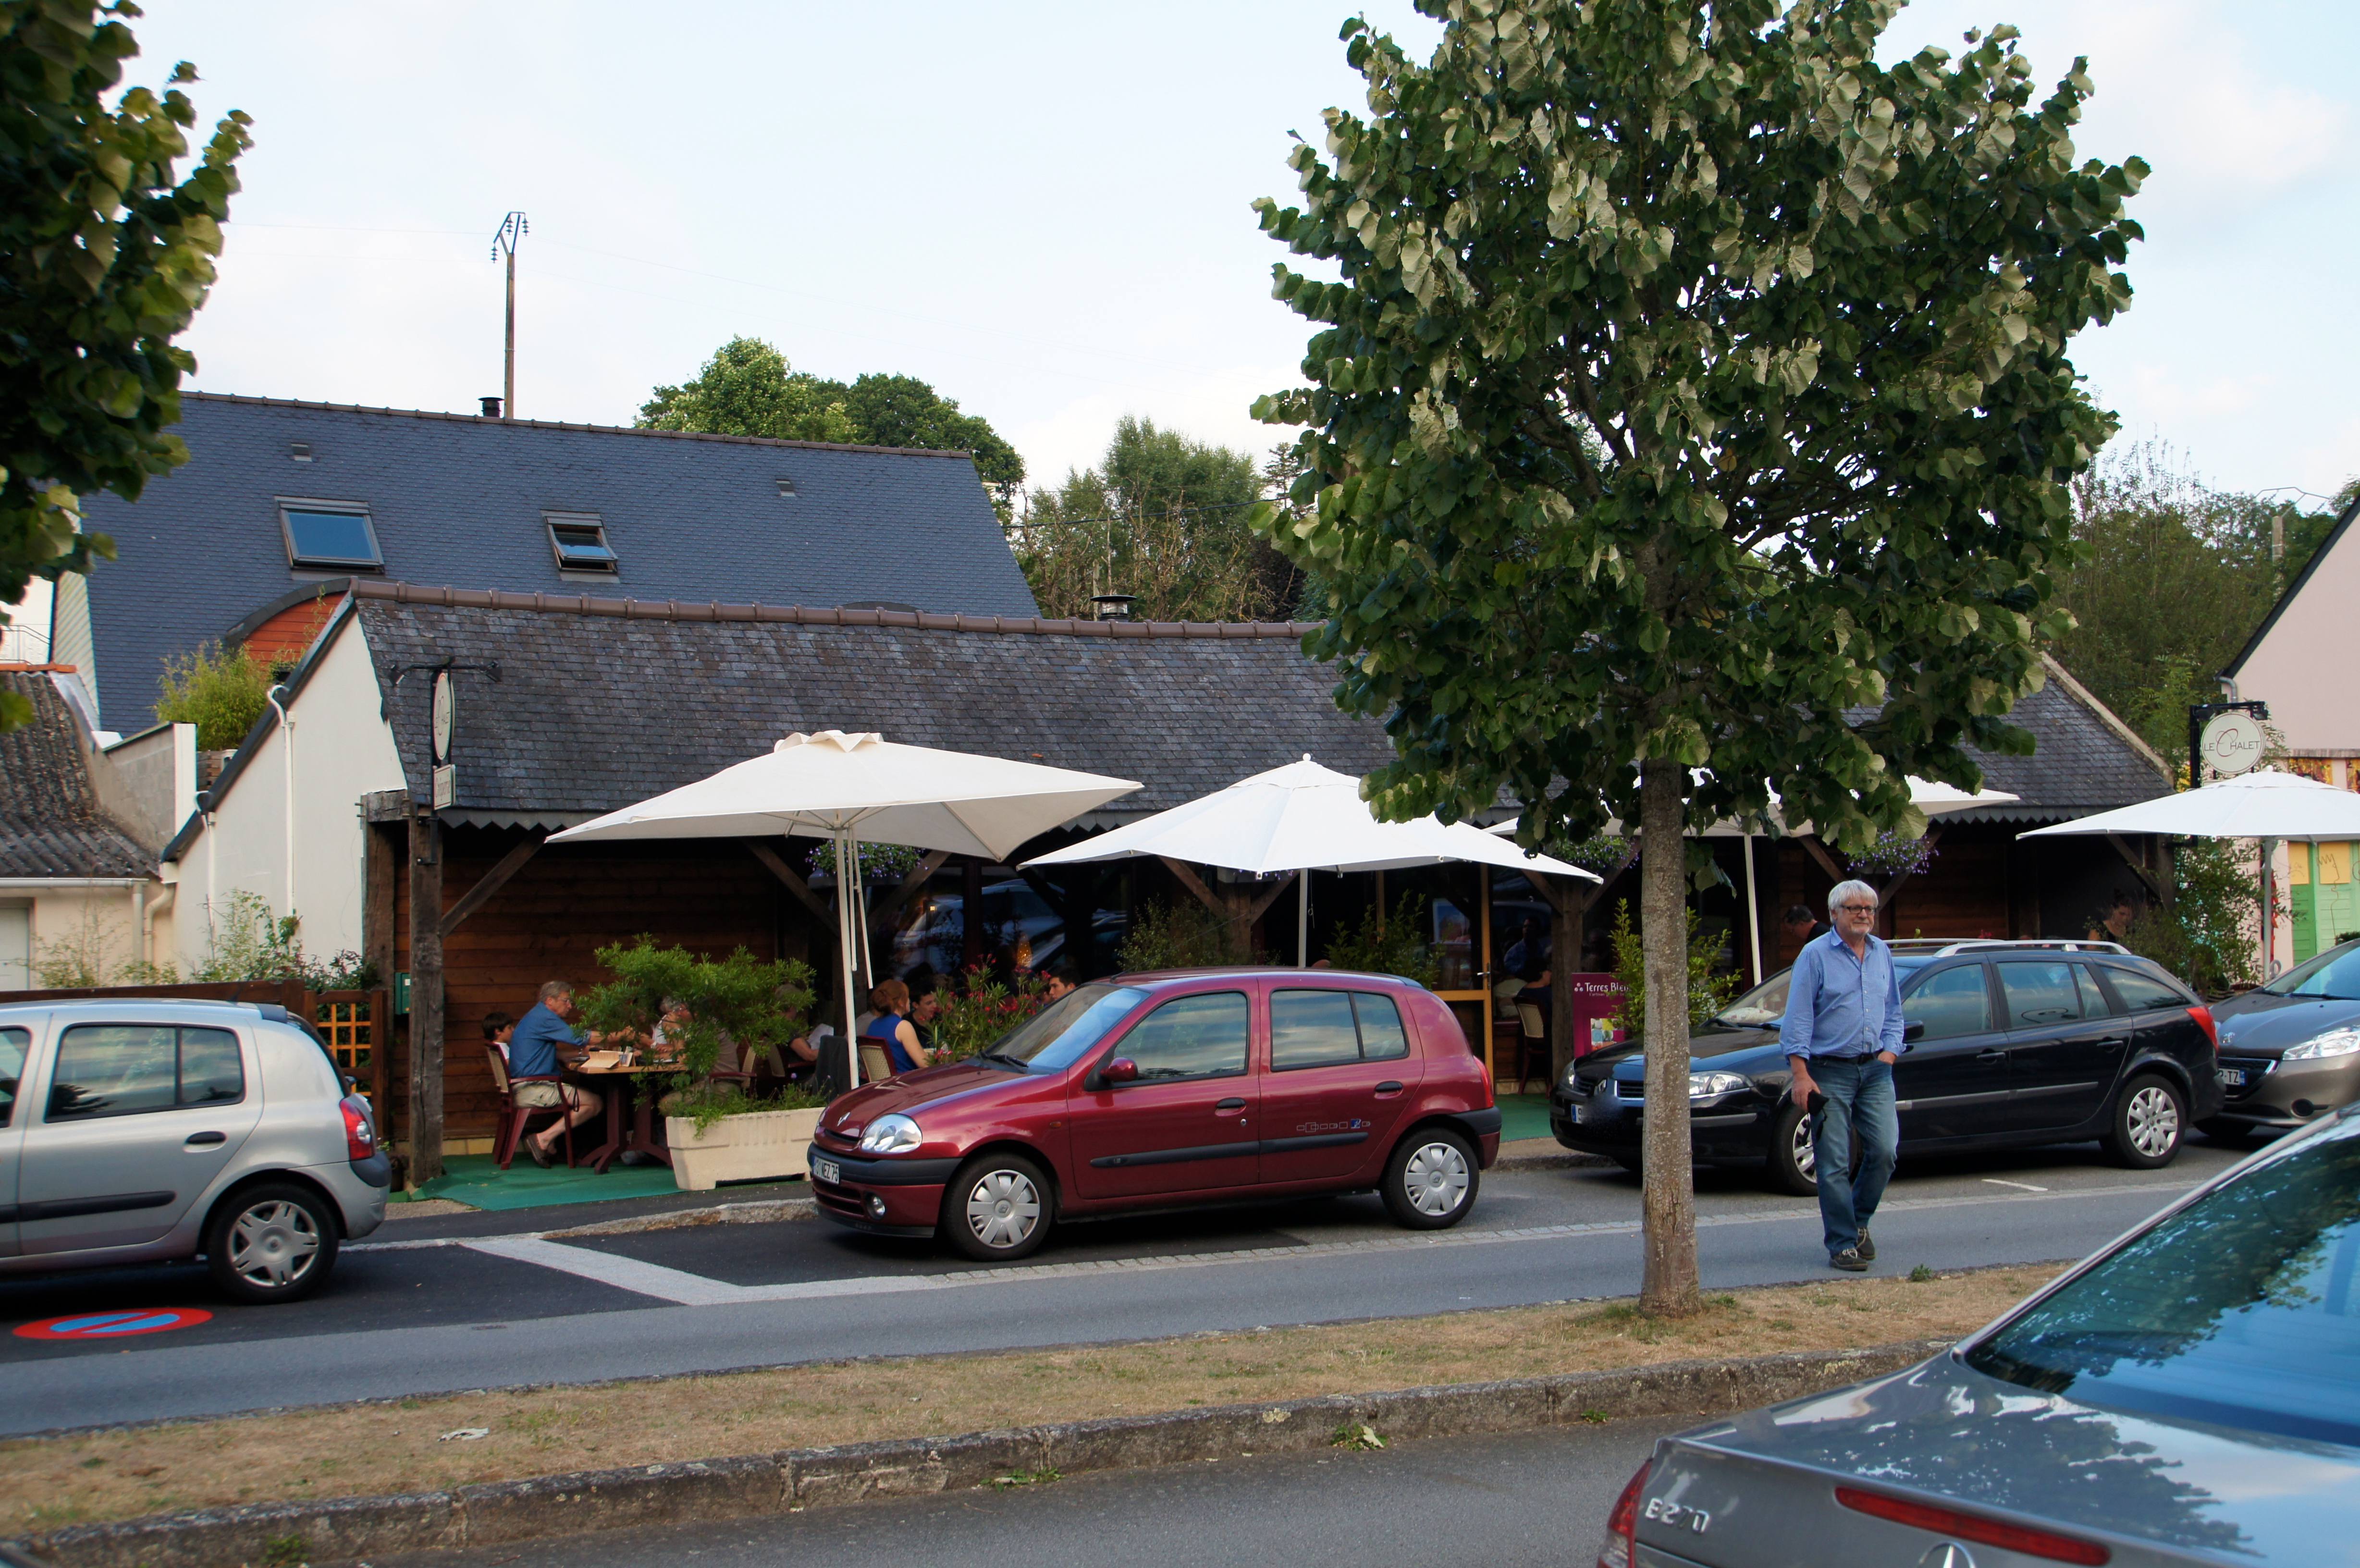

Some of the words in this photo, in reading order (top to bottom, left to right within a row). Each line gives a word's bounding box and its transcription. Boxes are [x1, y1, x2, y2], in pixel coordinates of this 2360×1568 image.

[2204, 743, 2215, 751] LE
[2215, 728, 2260, 757] CHALET
[1585, 982, 1609, 992] Terres
